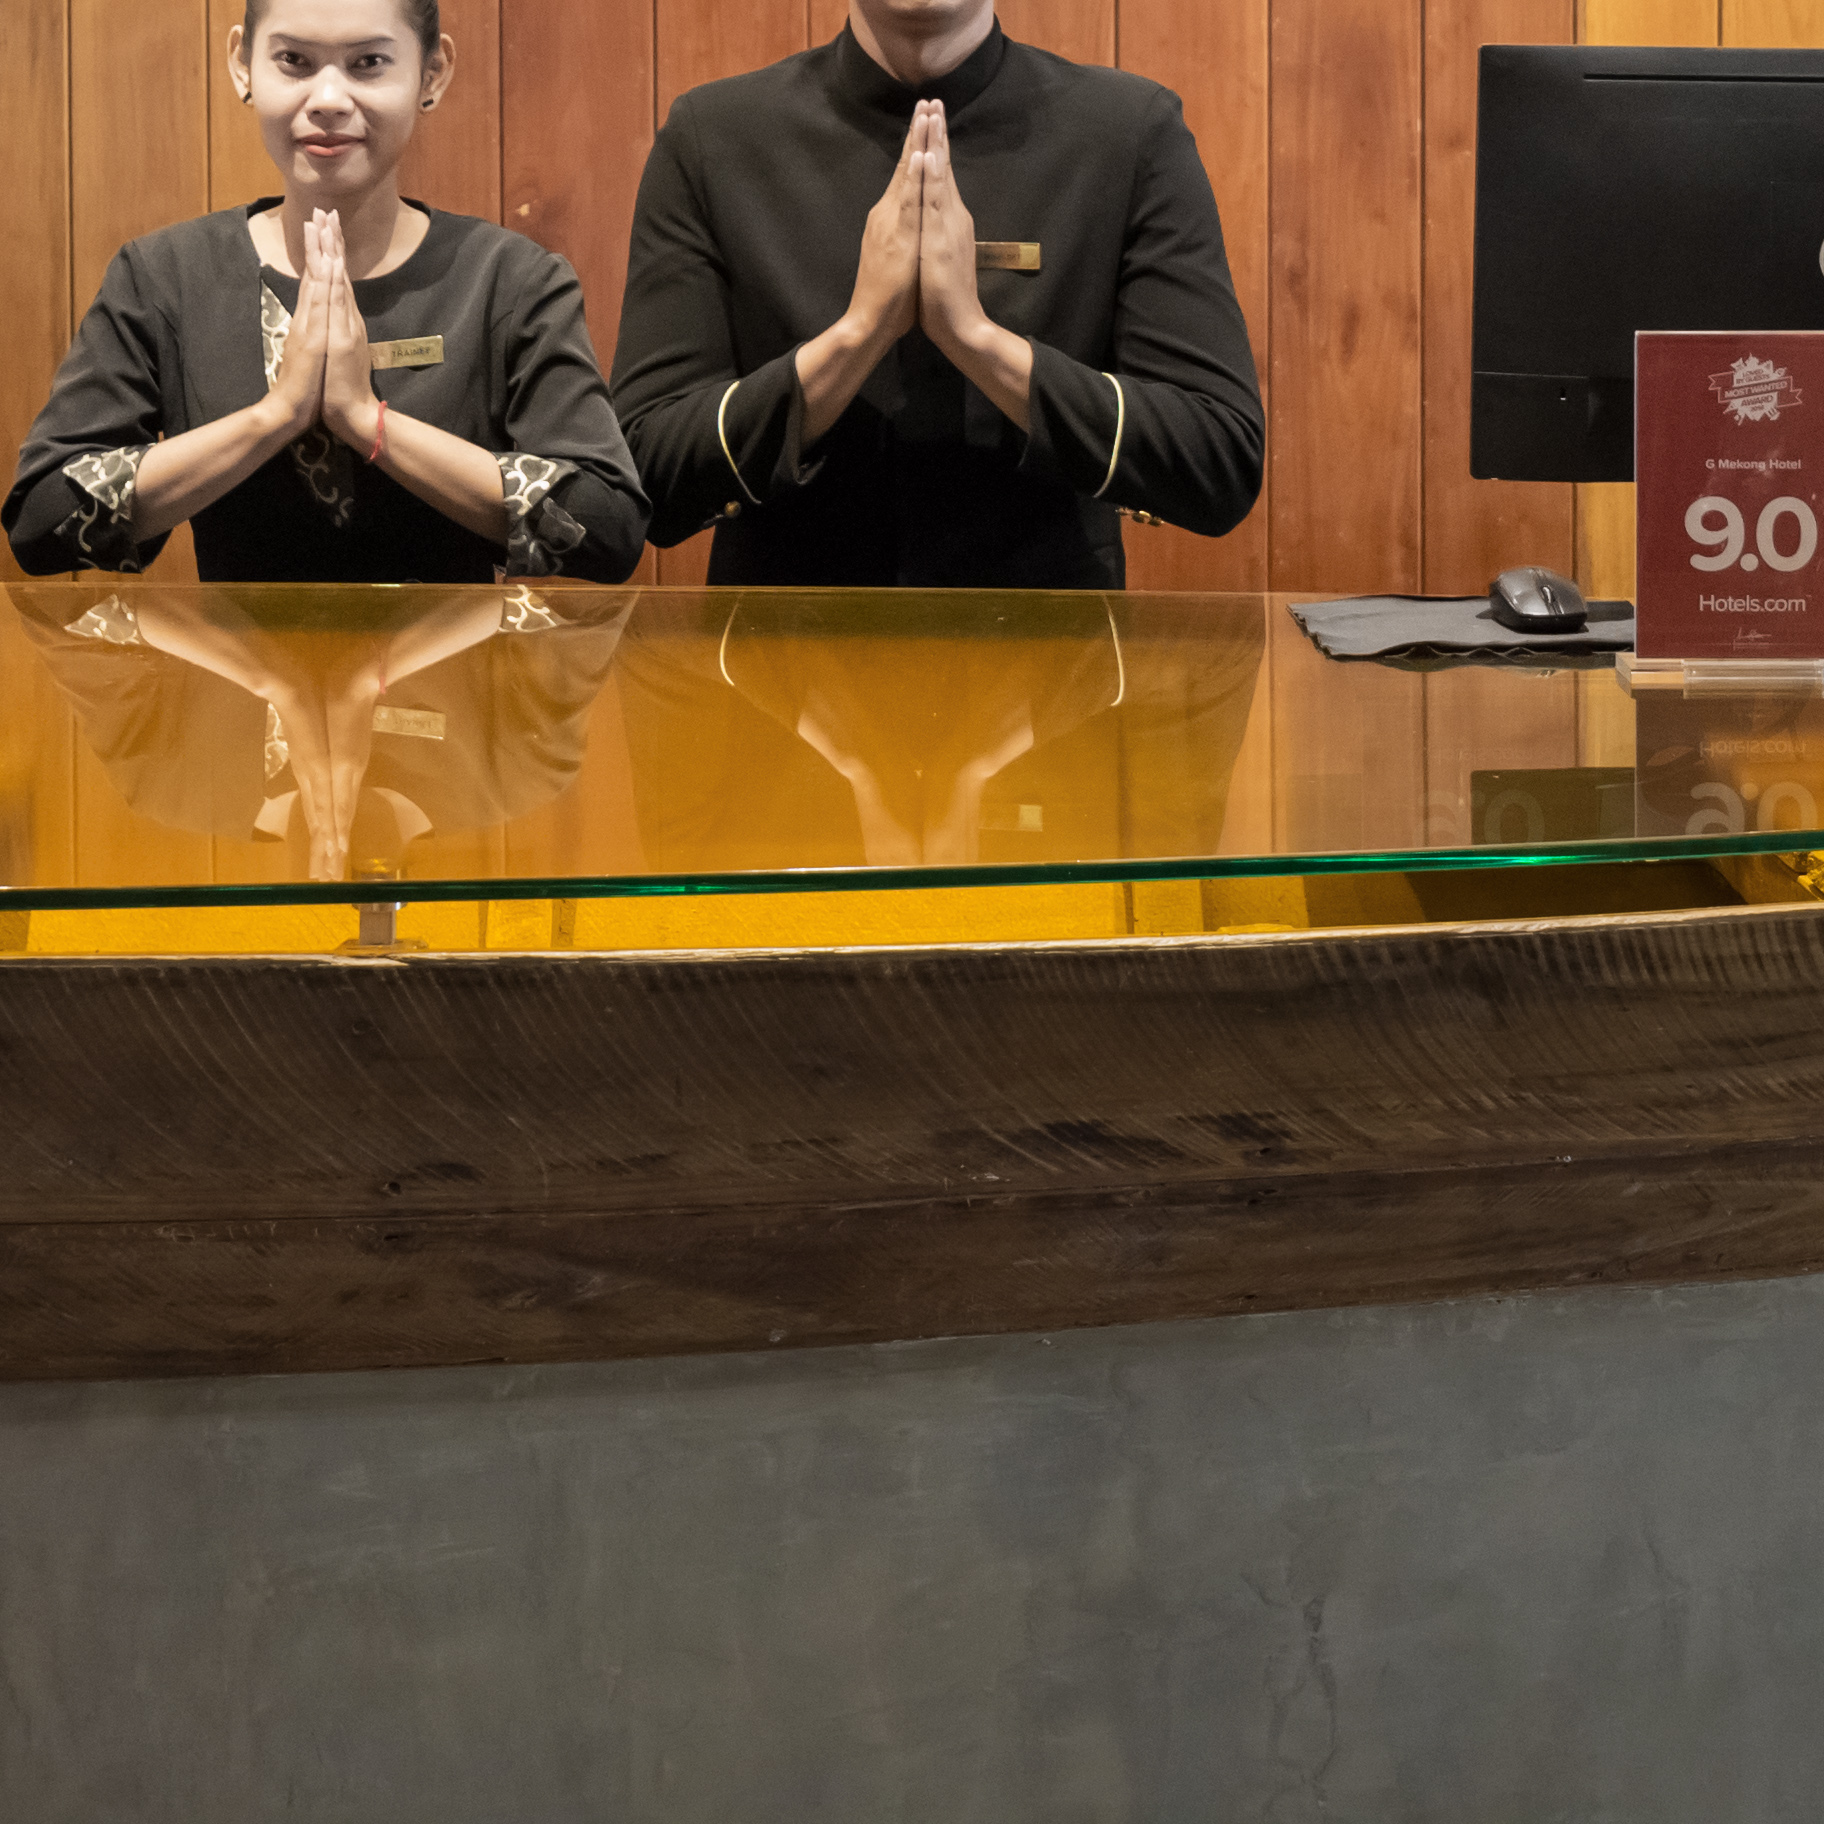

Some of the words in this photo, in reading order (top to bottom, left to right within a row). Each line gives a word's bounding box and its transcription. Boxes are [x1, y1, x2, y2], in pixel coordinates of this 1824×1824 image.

[1724, 387, 1750, 398] MOST
[1750, 381, 1788, 393] WANTED
[1741, 395, 1774, 406] AWARD
[1705, 459, 1715, 469] G
[1718, 459, 1766, 471] Mekong
[1769, 459, 1802, 469] Hotel
[1684, 496, 1818, 572] 9.0
[1699, 594, 1806, 612] Hotels.com
